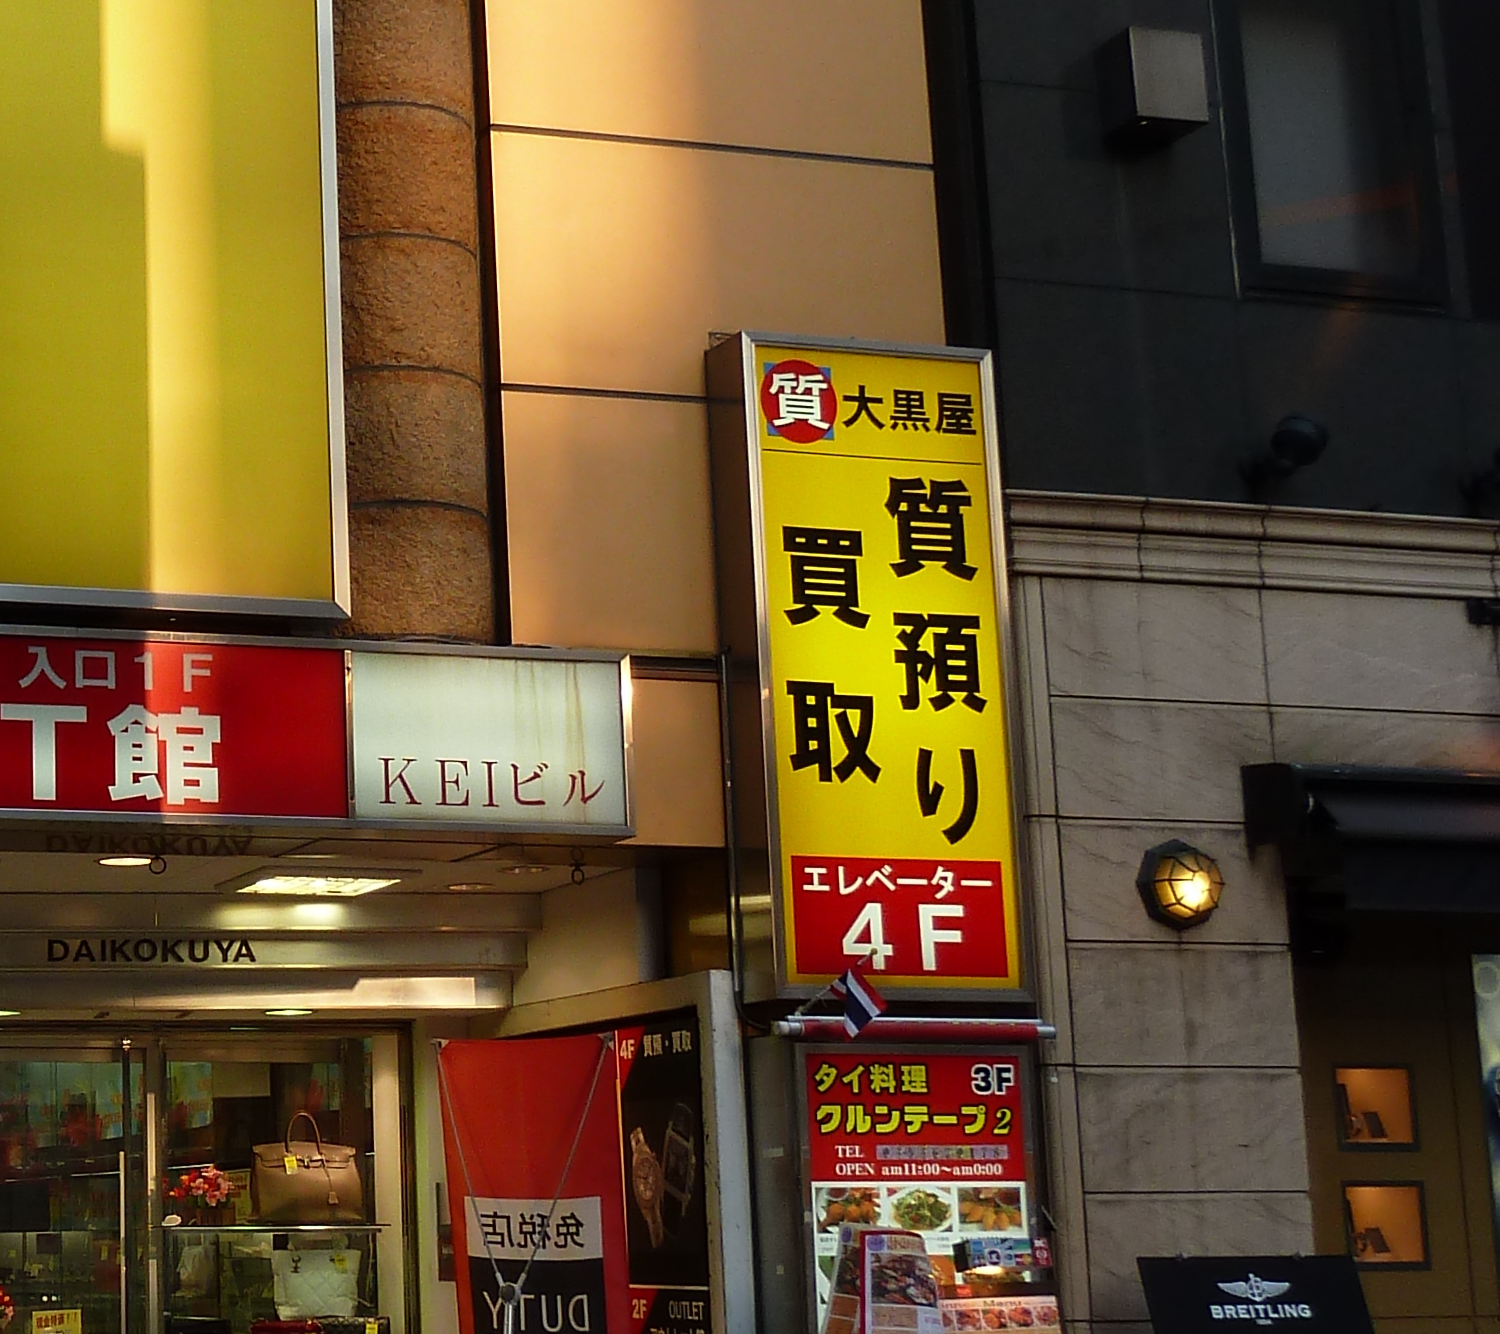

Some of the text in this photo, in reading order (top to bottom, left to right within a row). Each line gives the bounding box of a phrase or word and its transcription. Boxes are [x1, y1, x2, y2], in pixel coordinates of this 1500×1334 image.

[769, 371, 977, 436] 質 大黒屋
[781, 525, 882, 784] 買取
[884, 476, 989, 845] 質預り
[377, 756, 606, 808] KEIビル
[802, 864, 993, 899] エレベーター
[47, 939, 256, 963] DAIKOKUYA
[841, 902, 965, 971] 4F
[620, 1038, 635, 1060] 4F
[813, 1063, 1016, 1095] タイ料理 3F
[835, 1145, 864, 1158] TEL
[835, 1163, 874, 1175] OPEN
[632, 1298, 705, 1320] 2F OUTLET
[1209, 1303, 1313, 1319] BREITLING
